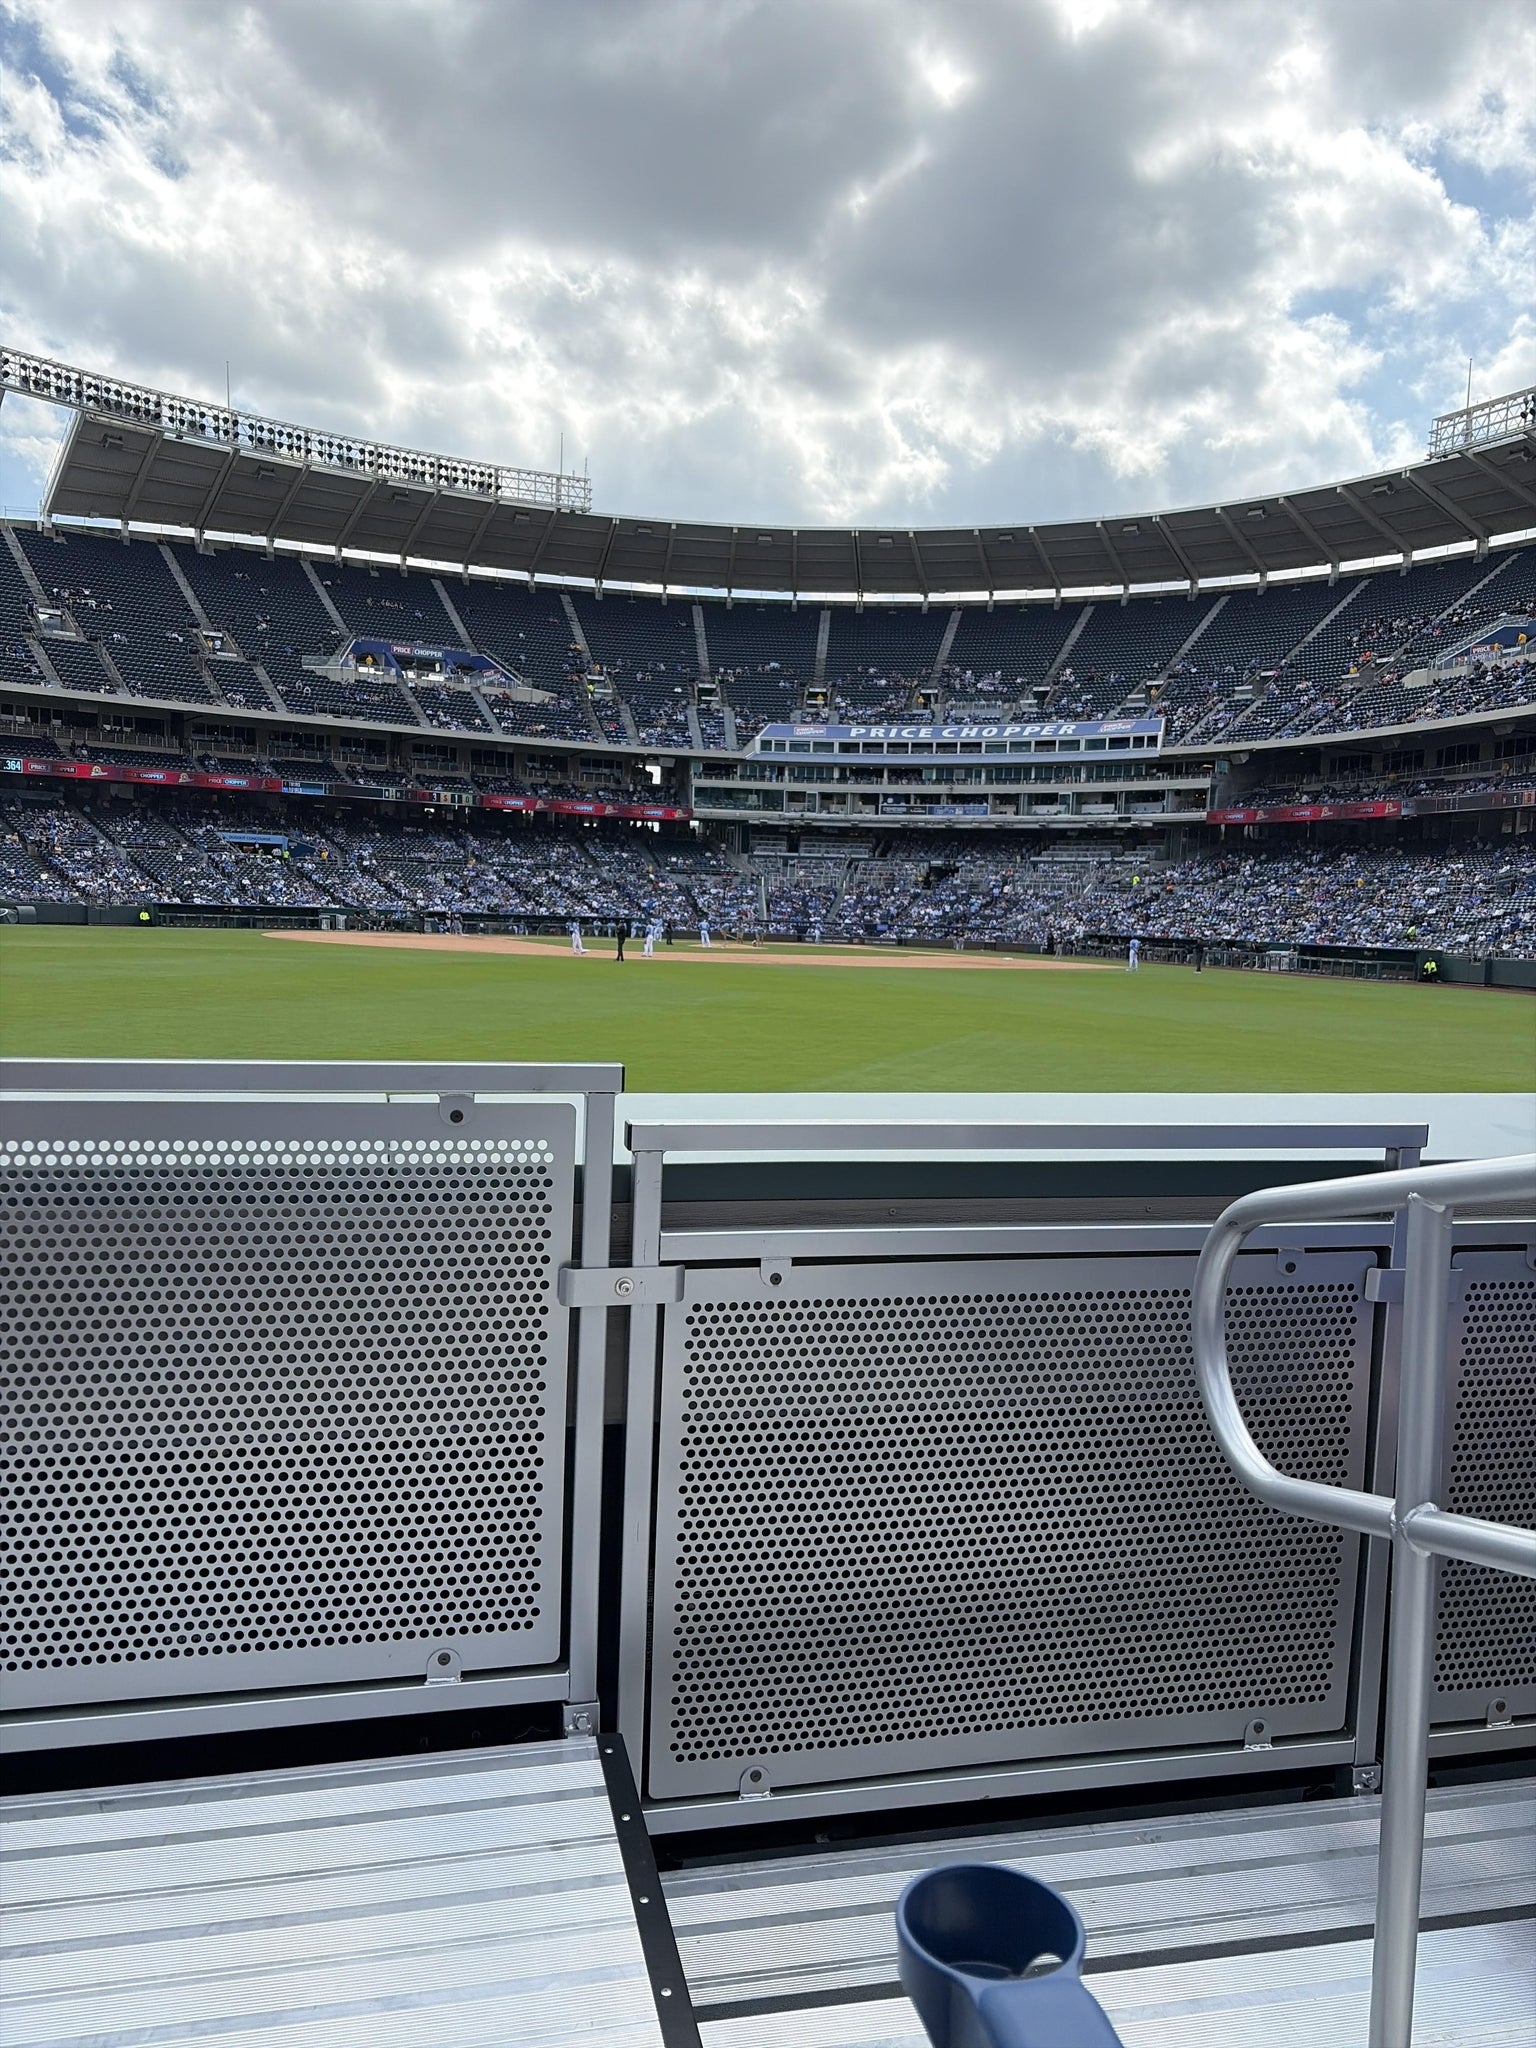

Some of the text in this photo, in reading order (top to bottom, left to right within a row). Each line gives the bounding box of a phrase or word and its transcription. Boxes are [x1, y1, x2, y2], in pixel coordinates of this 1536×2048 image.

[393, 646, 443, 658] PRICE CHOPPER
[850, 725, 1077, 738] PRICE CHOPPER
